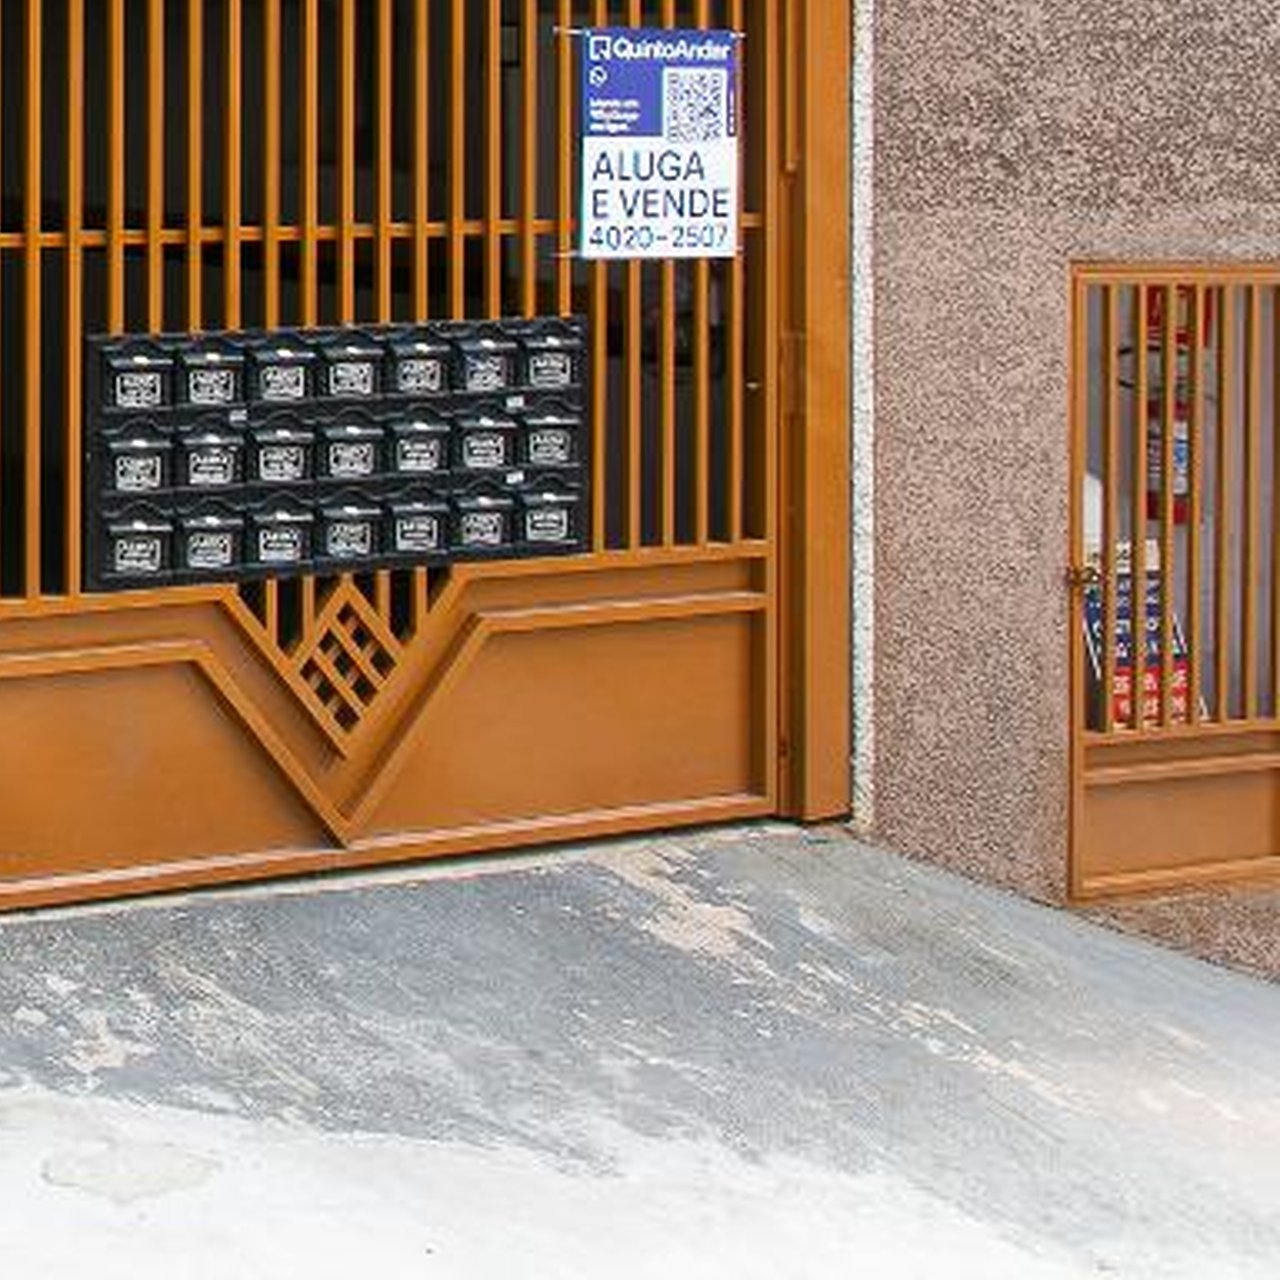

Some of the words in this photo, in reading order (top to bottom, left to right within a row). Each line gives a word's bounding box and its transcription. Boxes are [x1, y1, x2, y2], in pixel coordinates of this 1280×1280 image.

[592, 150, 706, 181] ALUGA
[592, 188, 609, 218] E
[619, 188, 729, 218] VENDE
[589, 225, 728, 250] 4020-2507
